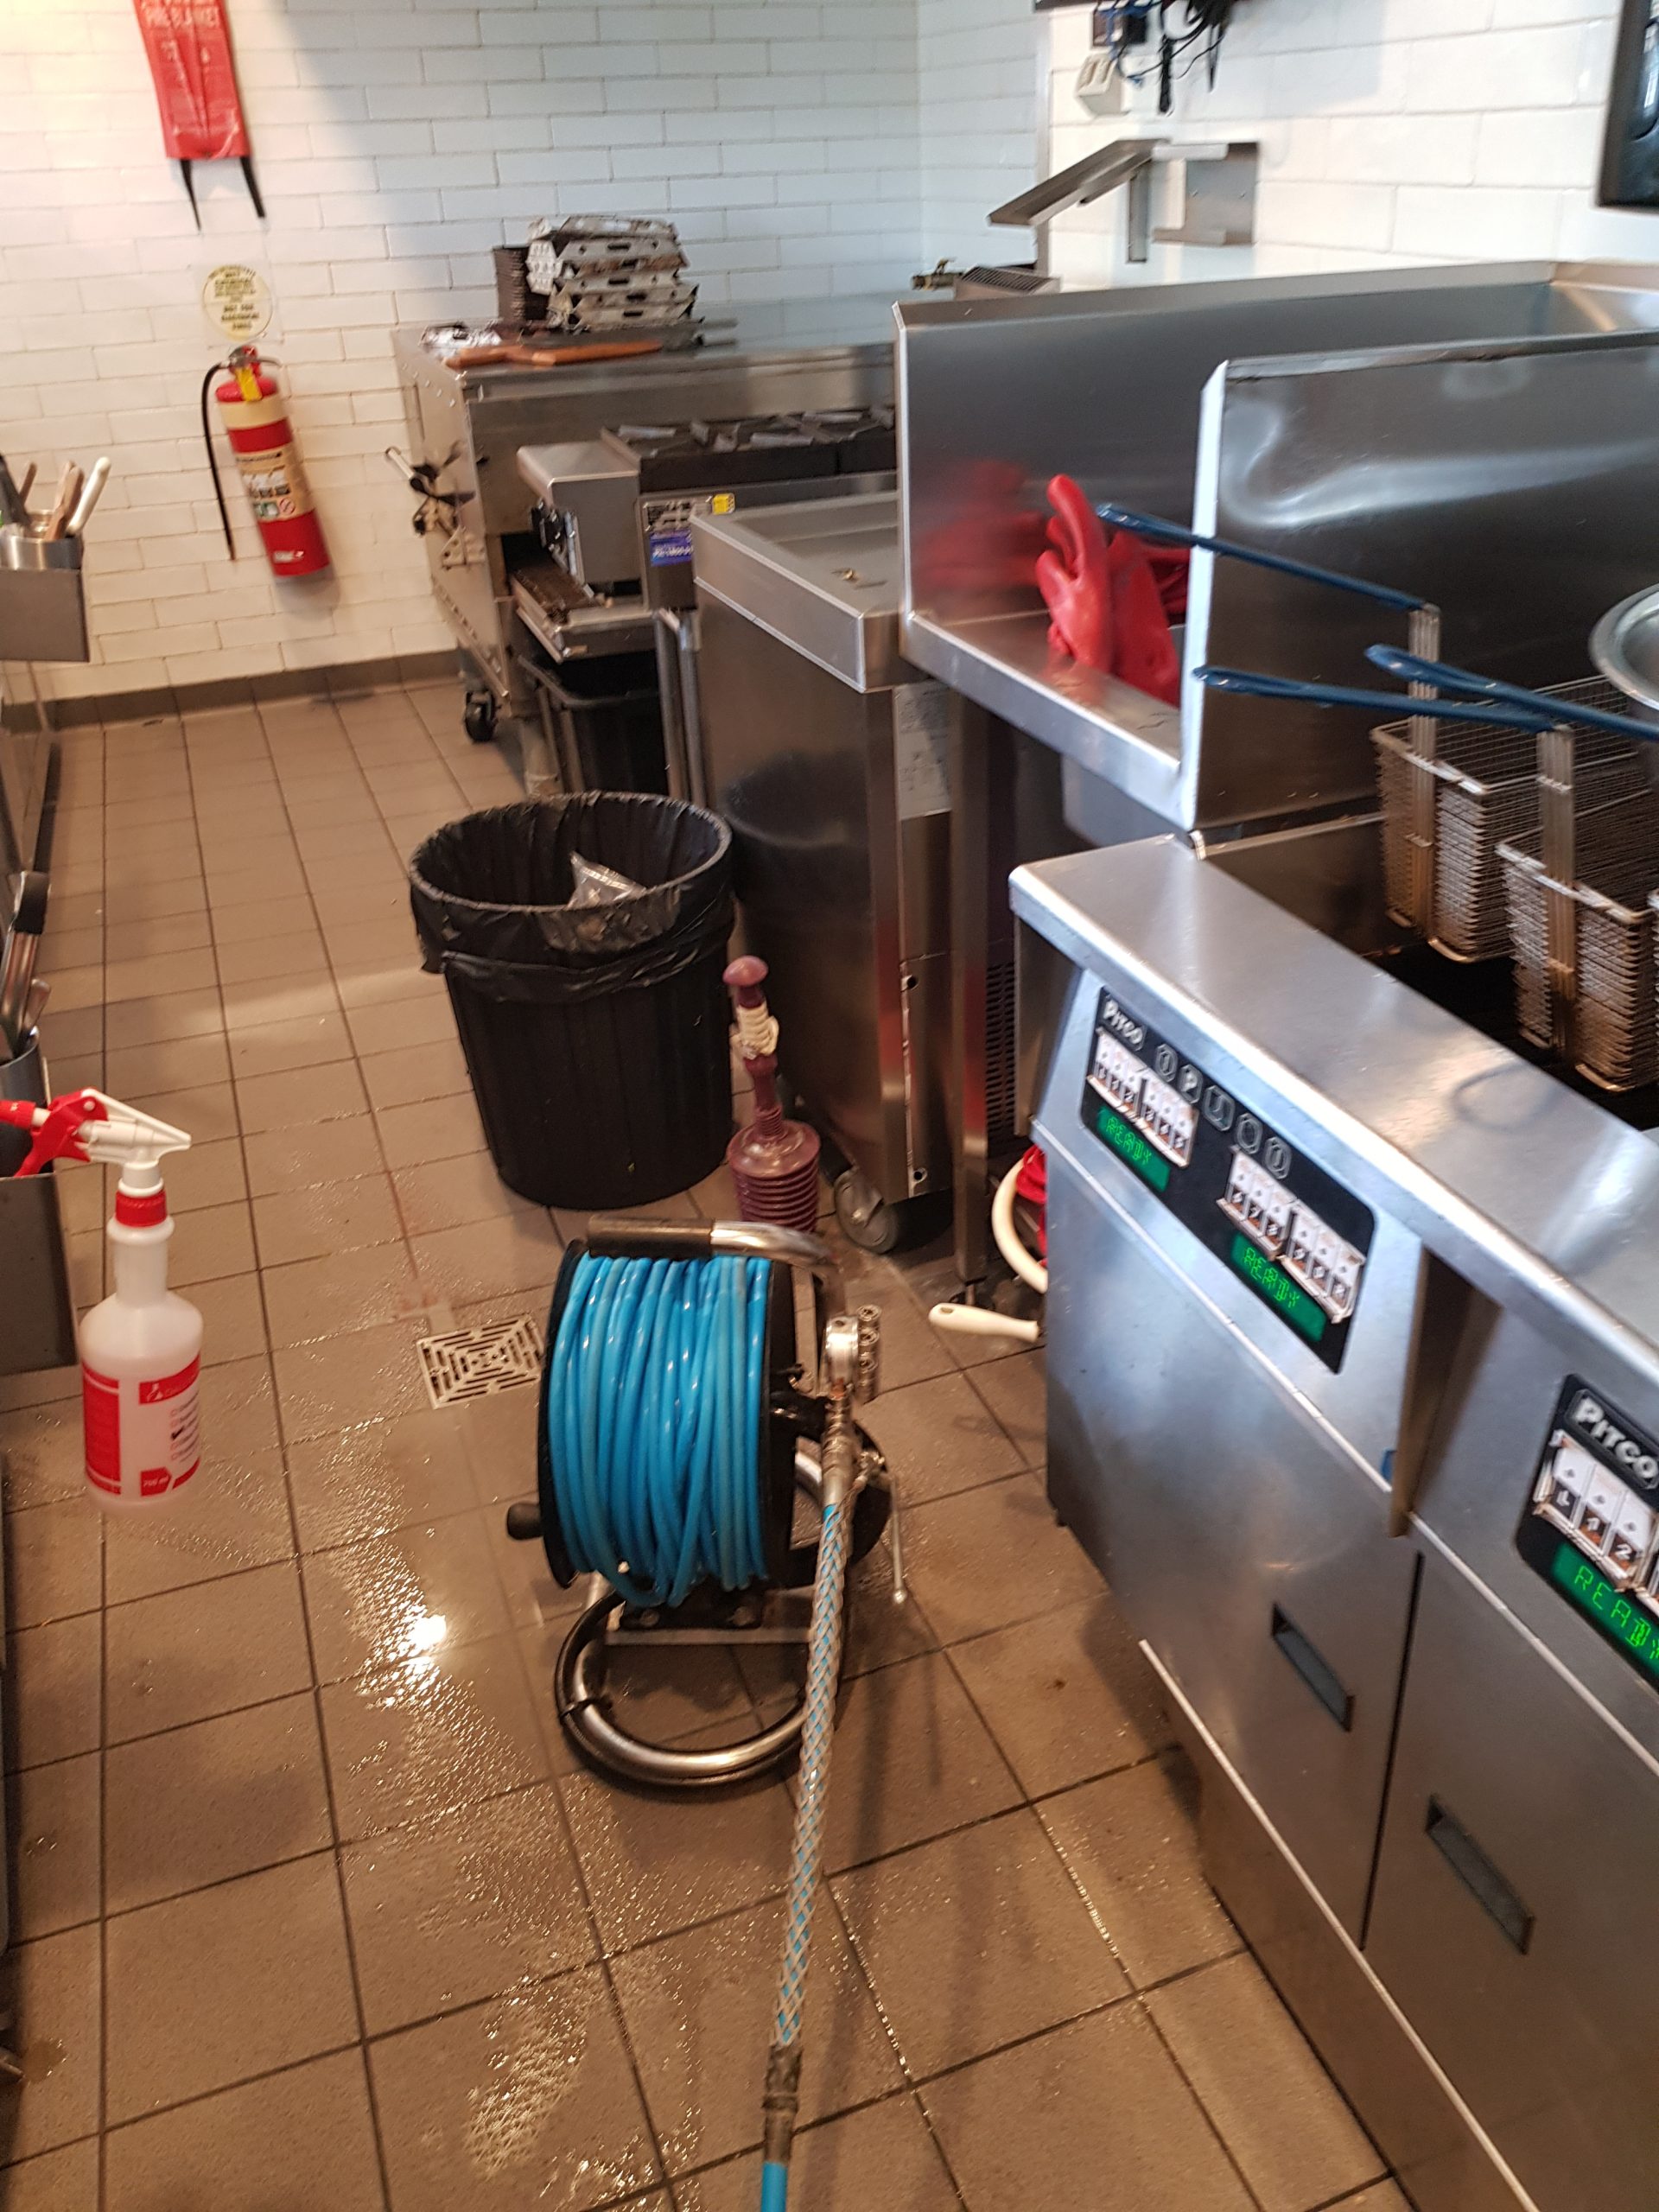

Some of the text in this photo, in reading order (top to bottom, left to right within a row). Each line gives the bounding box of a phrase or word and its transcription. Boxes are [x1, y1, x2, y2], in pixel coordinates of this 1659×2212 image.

[1106, 1116, 1153, 1165] READY
[1244, 1247, 1300, 1308] READY
[1575, 1397, 1659, 1479] PITCO
[1615, 1542, 1633, 1560] 2
